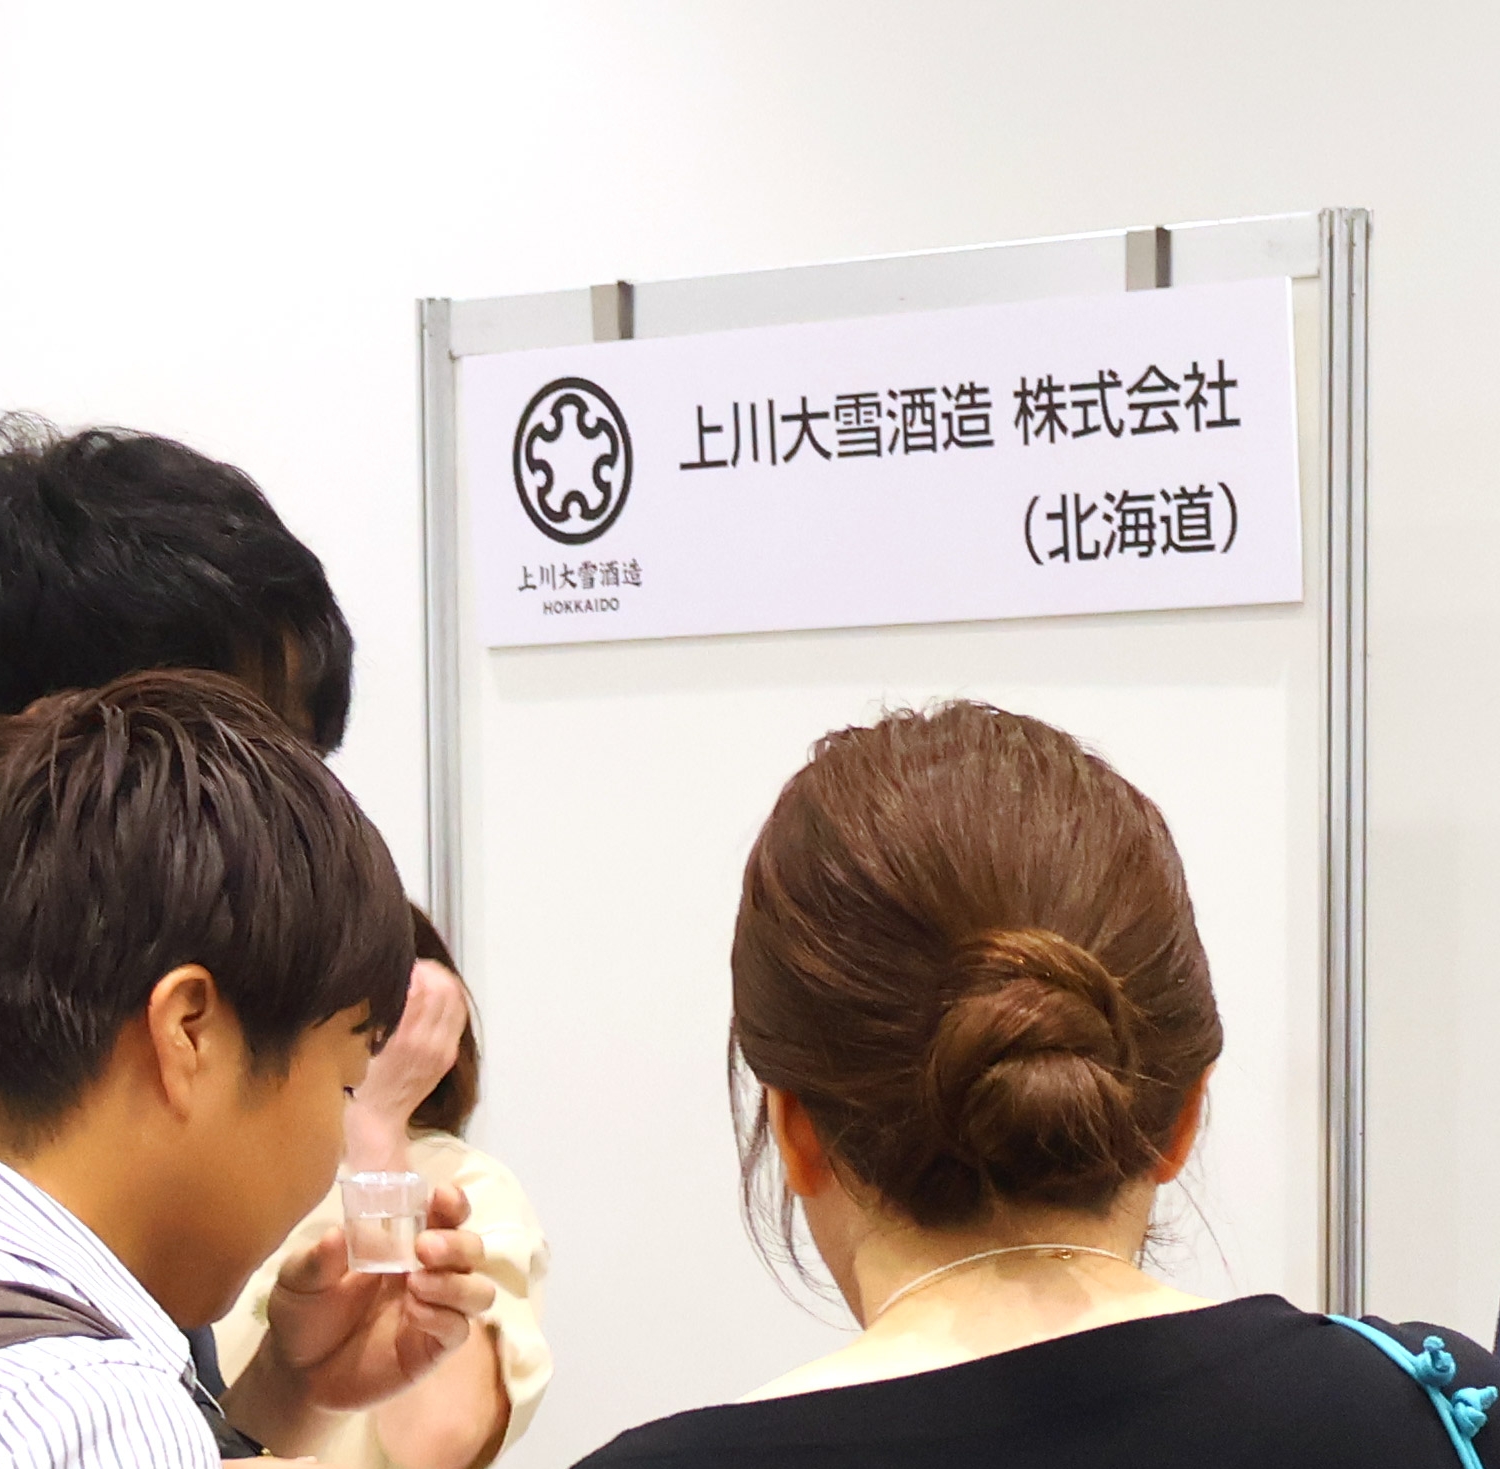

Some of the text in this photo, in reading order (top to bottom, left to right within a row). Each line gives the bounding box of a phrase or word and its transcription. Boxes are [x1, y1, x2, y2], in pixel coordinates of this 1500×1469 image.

[679, 359, 1242, 471] 上川大雪酒造 株式会社
[1024, 482, 1238, 566] （北海道）
[518, 558, 643, 592] 上川大雪酒造
[543, 598, 620, 614] HOKKAIDO
